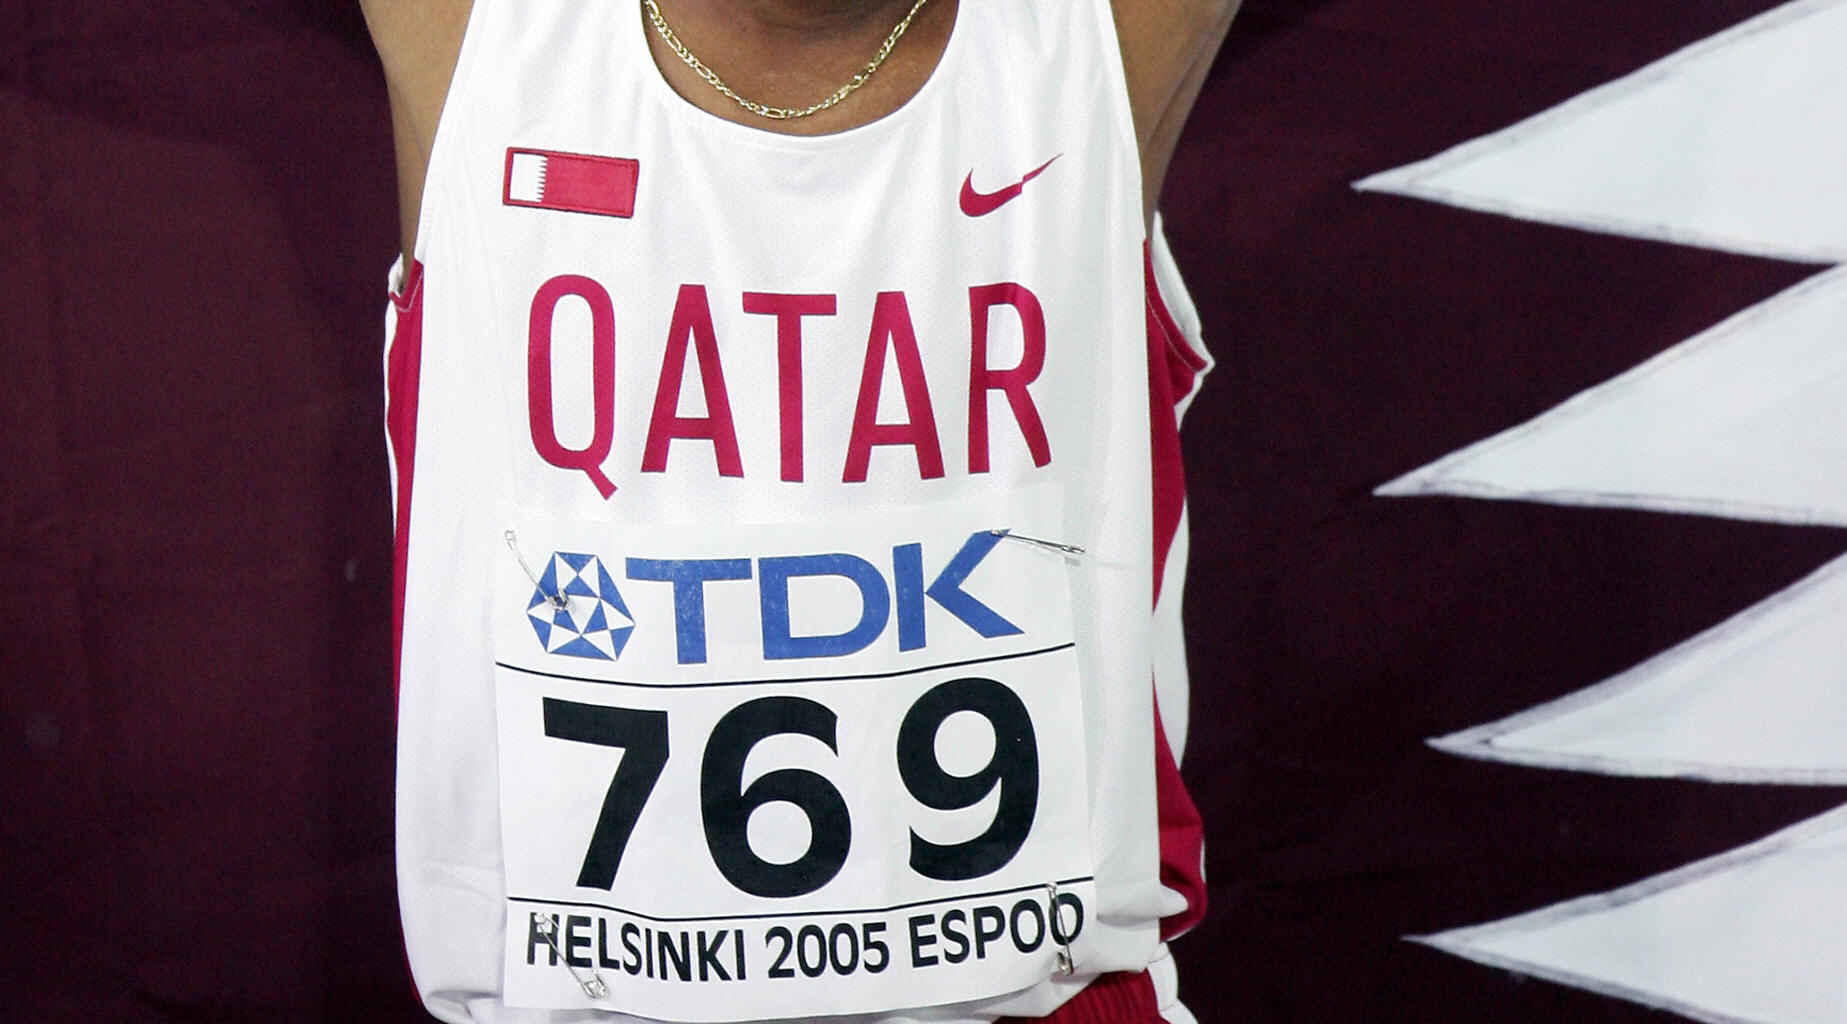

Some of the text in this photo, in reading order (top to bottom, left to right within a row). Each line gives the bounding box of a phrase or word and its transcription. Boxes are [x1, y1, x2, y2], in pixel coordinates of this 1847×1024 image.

[527, 274, 1052, 501] QATAR
[625, 528, 1025, 665] TDK
[542, 677, 1040, 898] 769
[526, 893, 1085, 982] HELSINKI 2005 ESPOO
